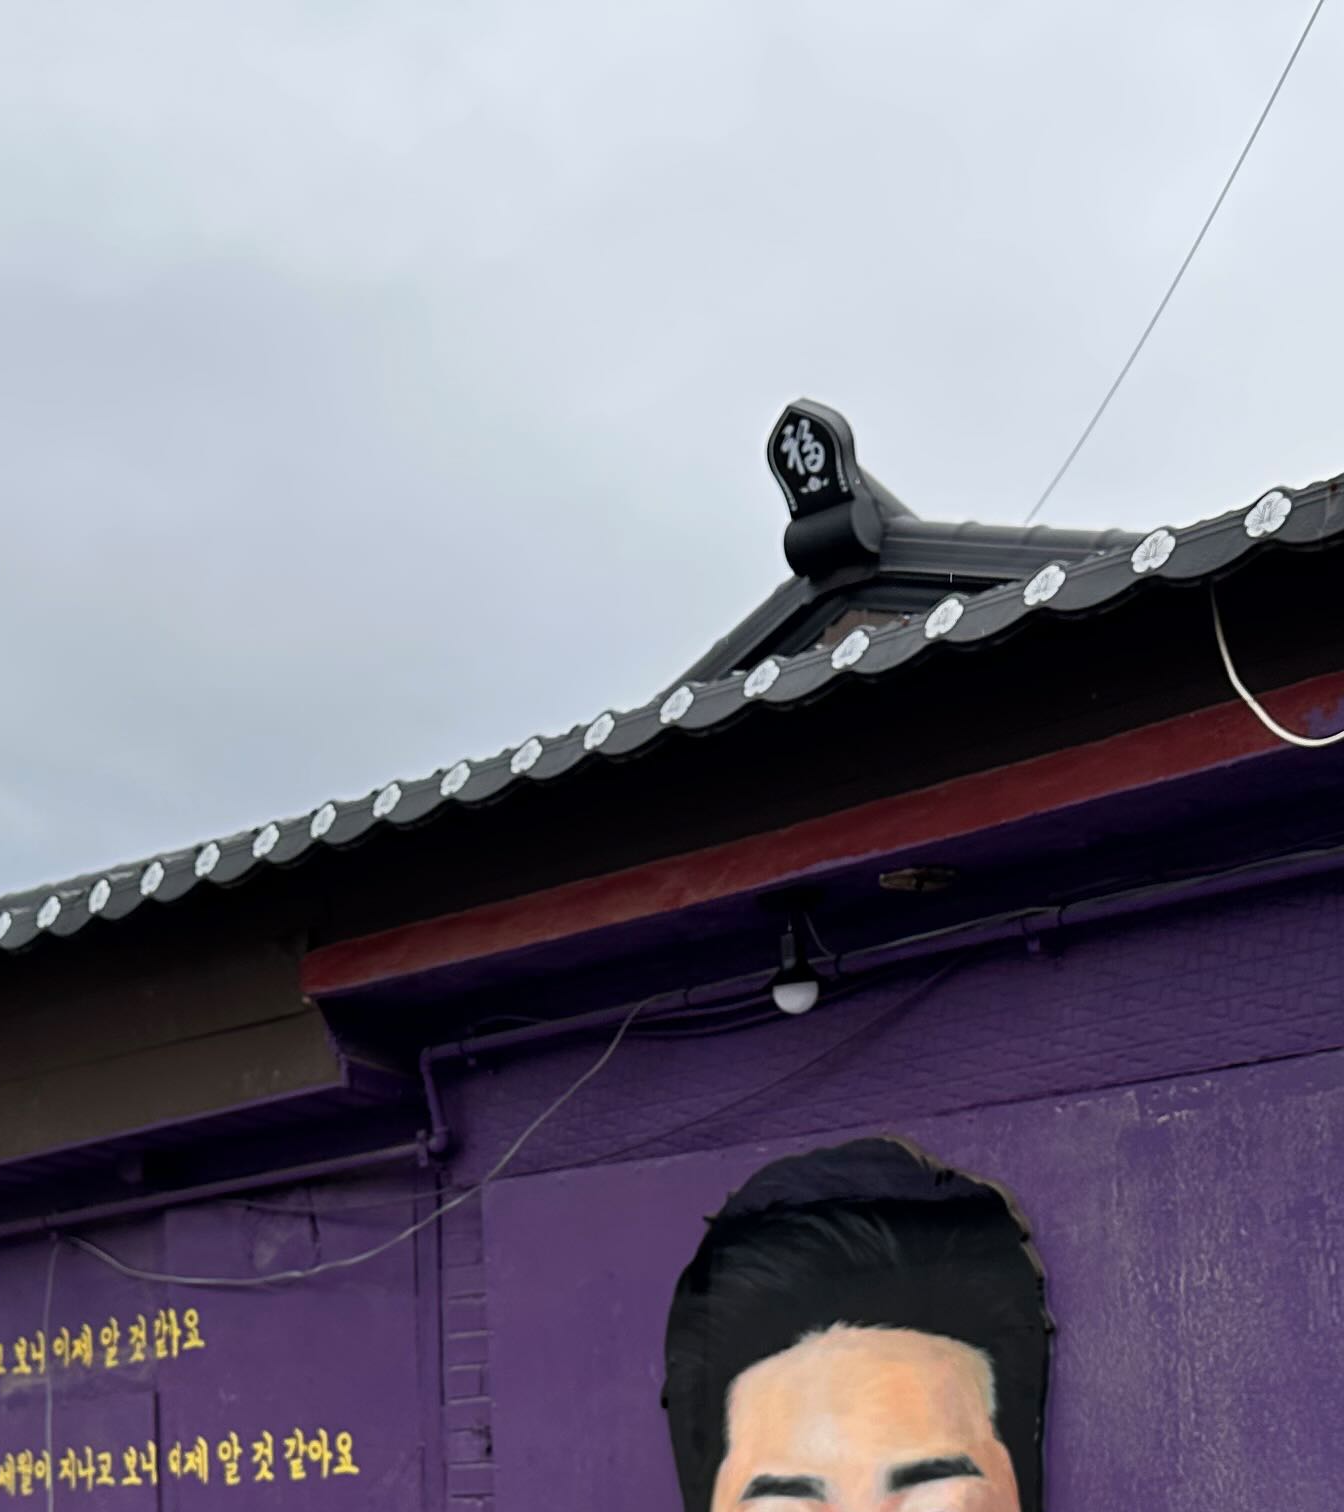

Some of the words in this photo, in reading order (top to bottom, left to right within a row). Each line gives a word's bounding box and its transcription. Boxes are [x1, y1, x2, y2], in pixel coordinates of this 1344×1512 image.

[780, 418, 826, 476] 福
[10, 1329, 48, 1377] 보니
[51, 1322, 95, 1369] 이제
[98, 1316, 121, 1370] 알
[127, 1313, 149, 1363] 것
[57, 1445, 117, 1492] 지나고
[120, 1439, 158, 1488] 보니
[215, 1430, 244, 1487] 알
[251, 1429, 275, 1484] 것
[283, 1426, 361, 1482] 같아요
